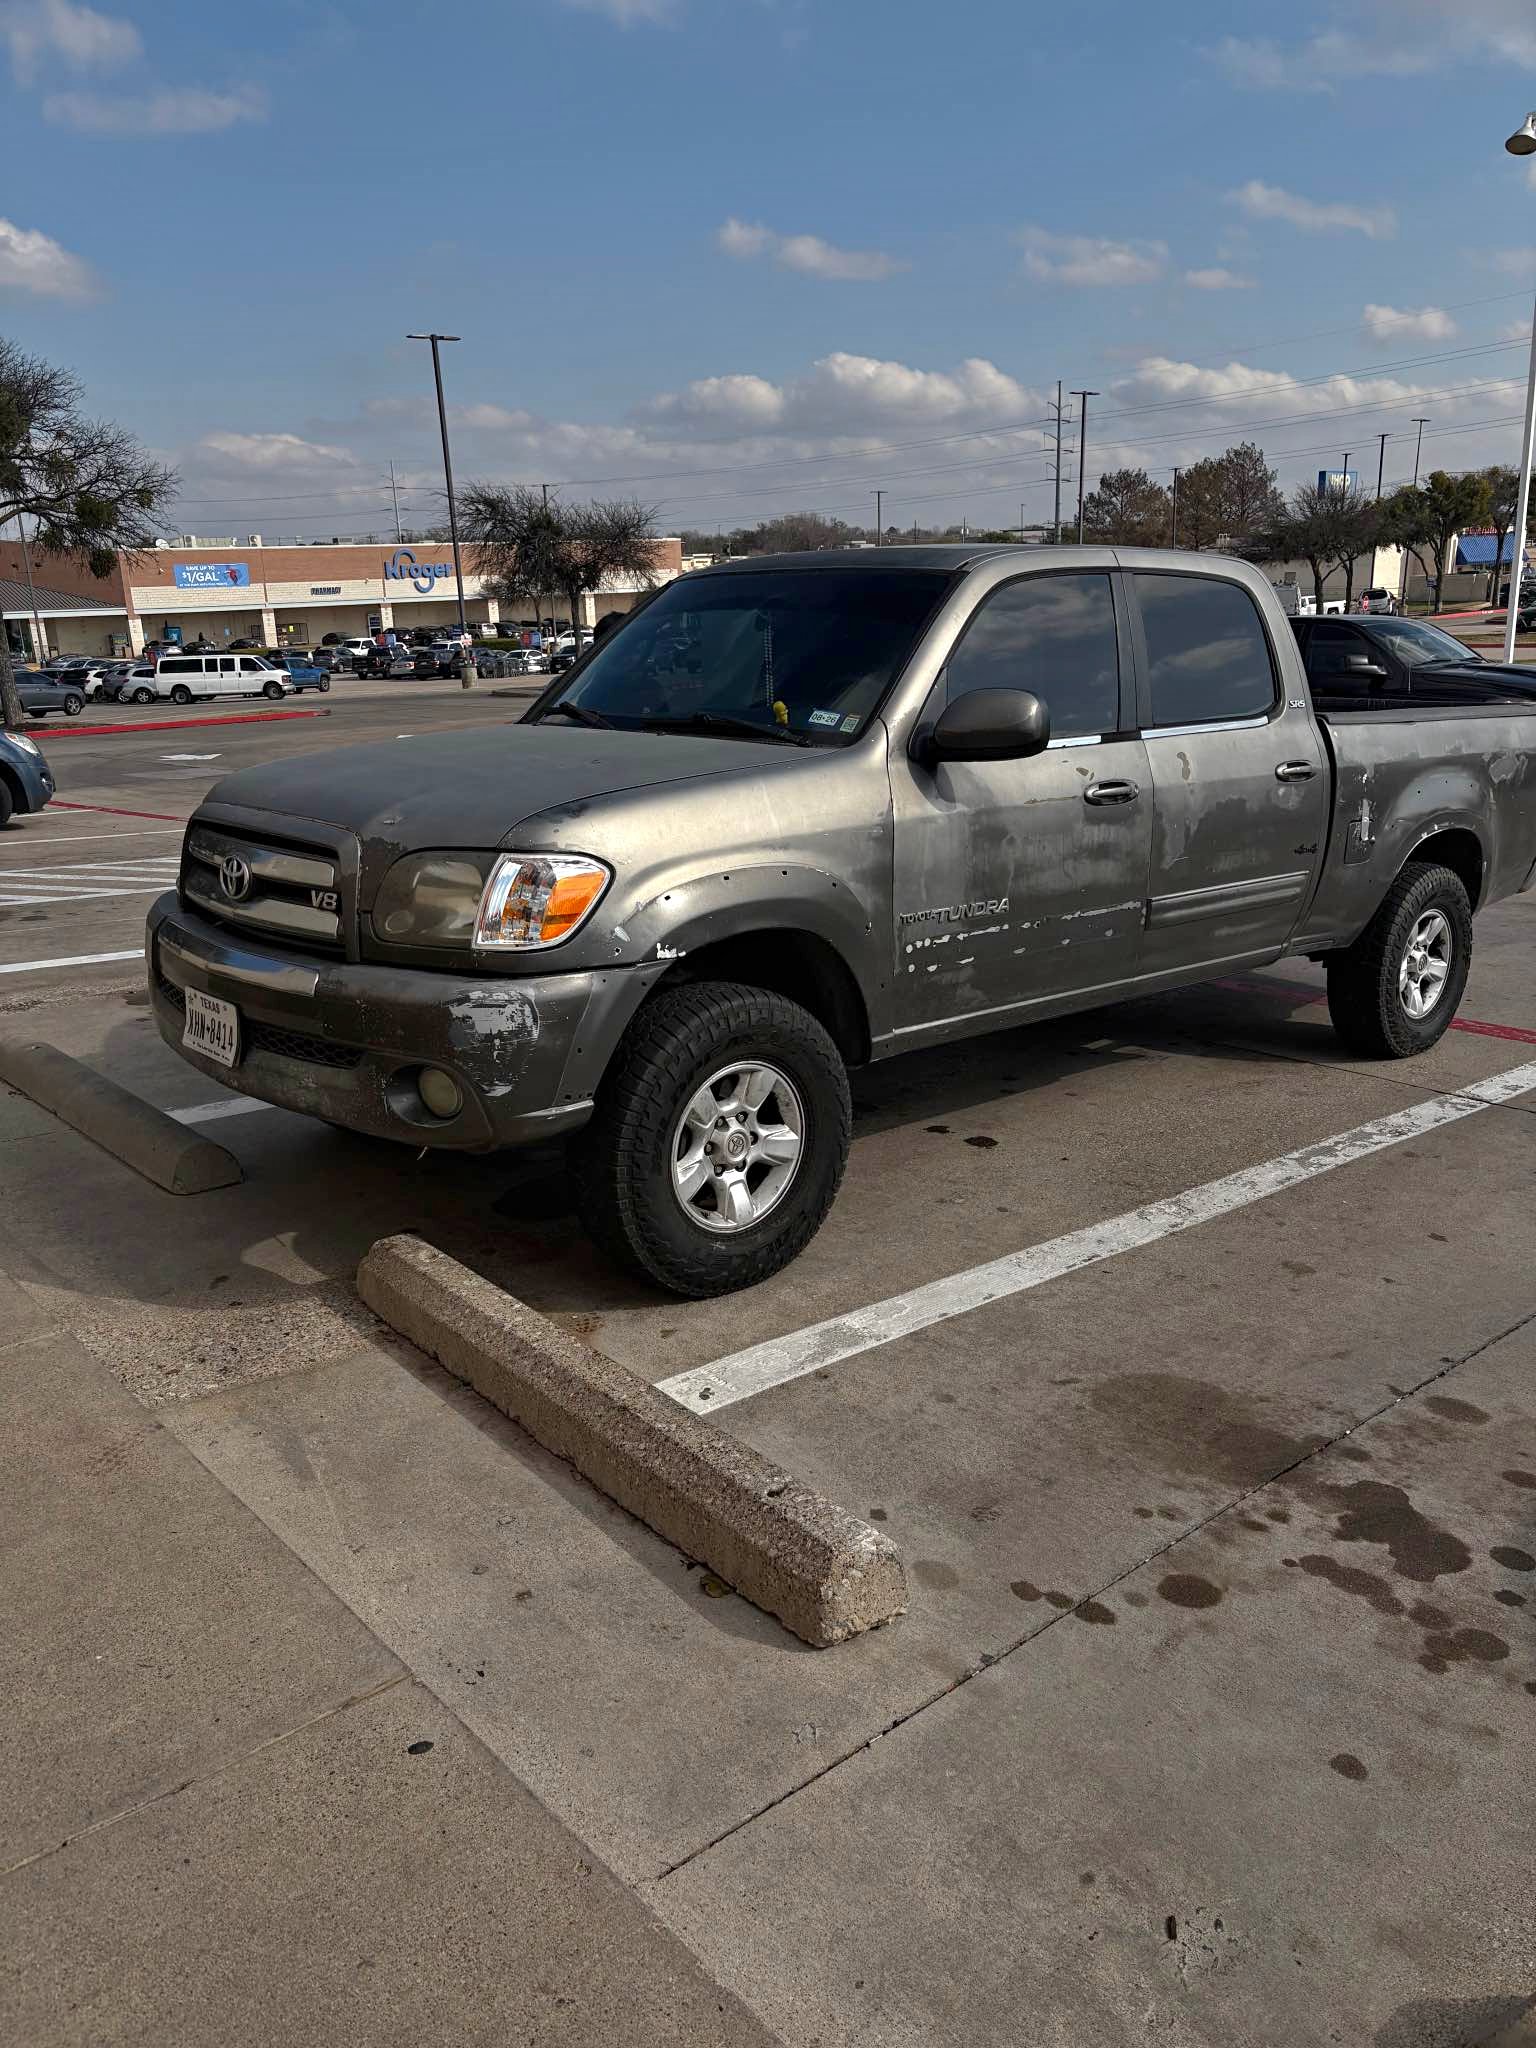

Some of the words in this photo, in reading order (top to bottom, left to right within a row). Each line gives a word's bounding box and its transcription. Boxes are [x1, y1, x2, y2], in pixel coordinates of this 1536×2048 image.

[384, 547, 453, 593] Kroger
[310, 890, 337, 910] V8
[899, 910, 937, 924] TOYOTA
[936, 898, 1009, 923] TUNDRA
[200, 996, 221, 1014] TEXAS
